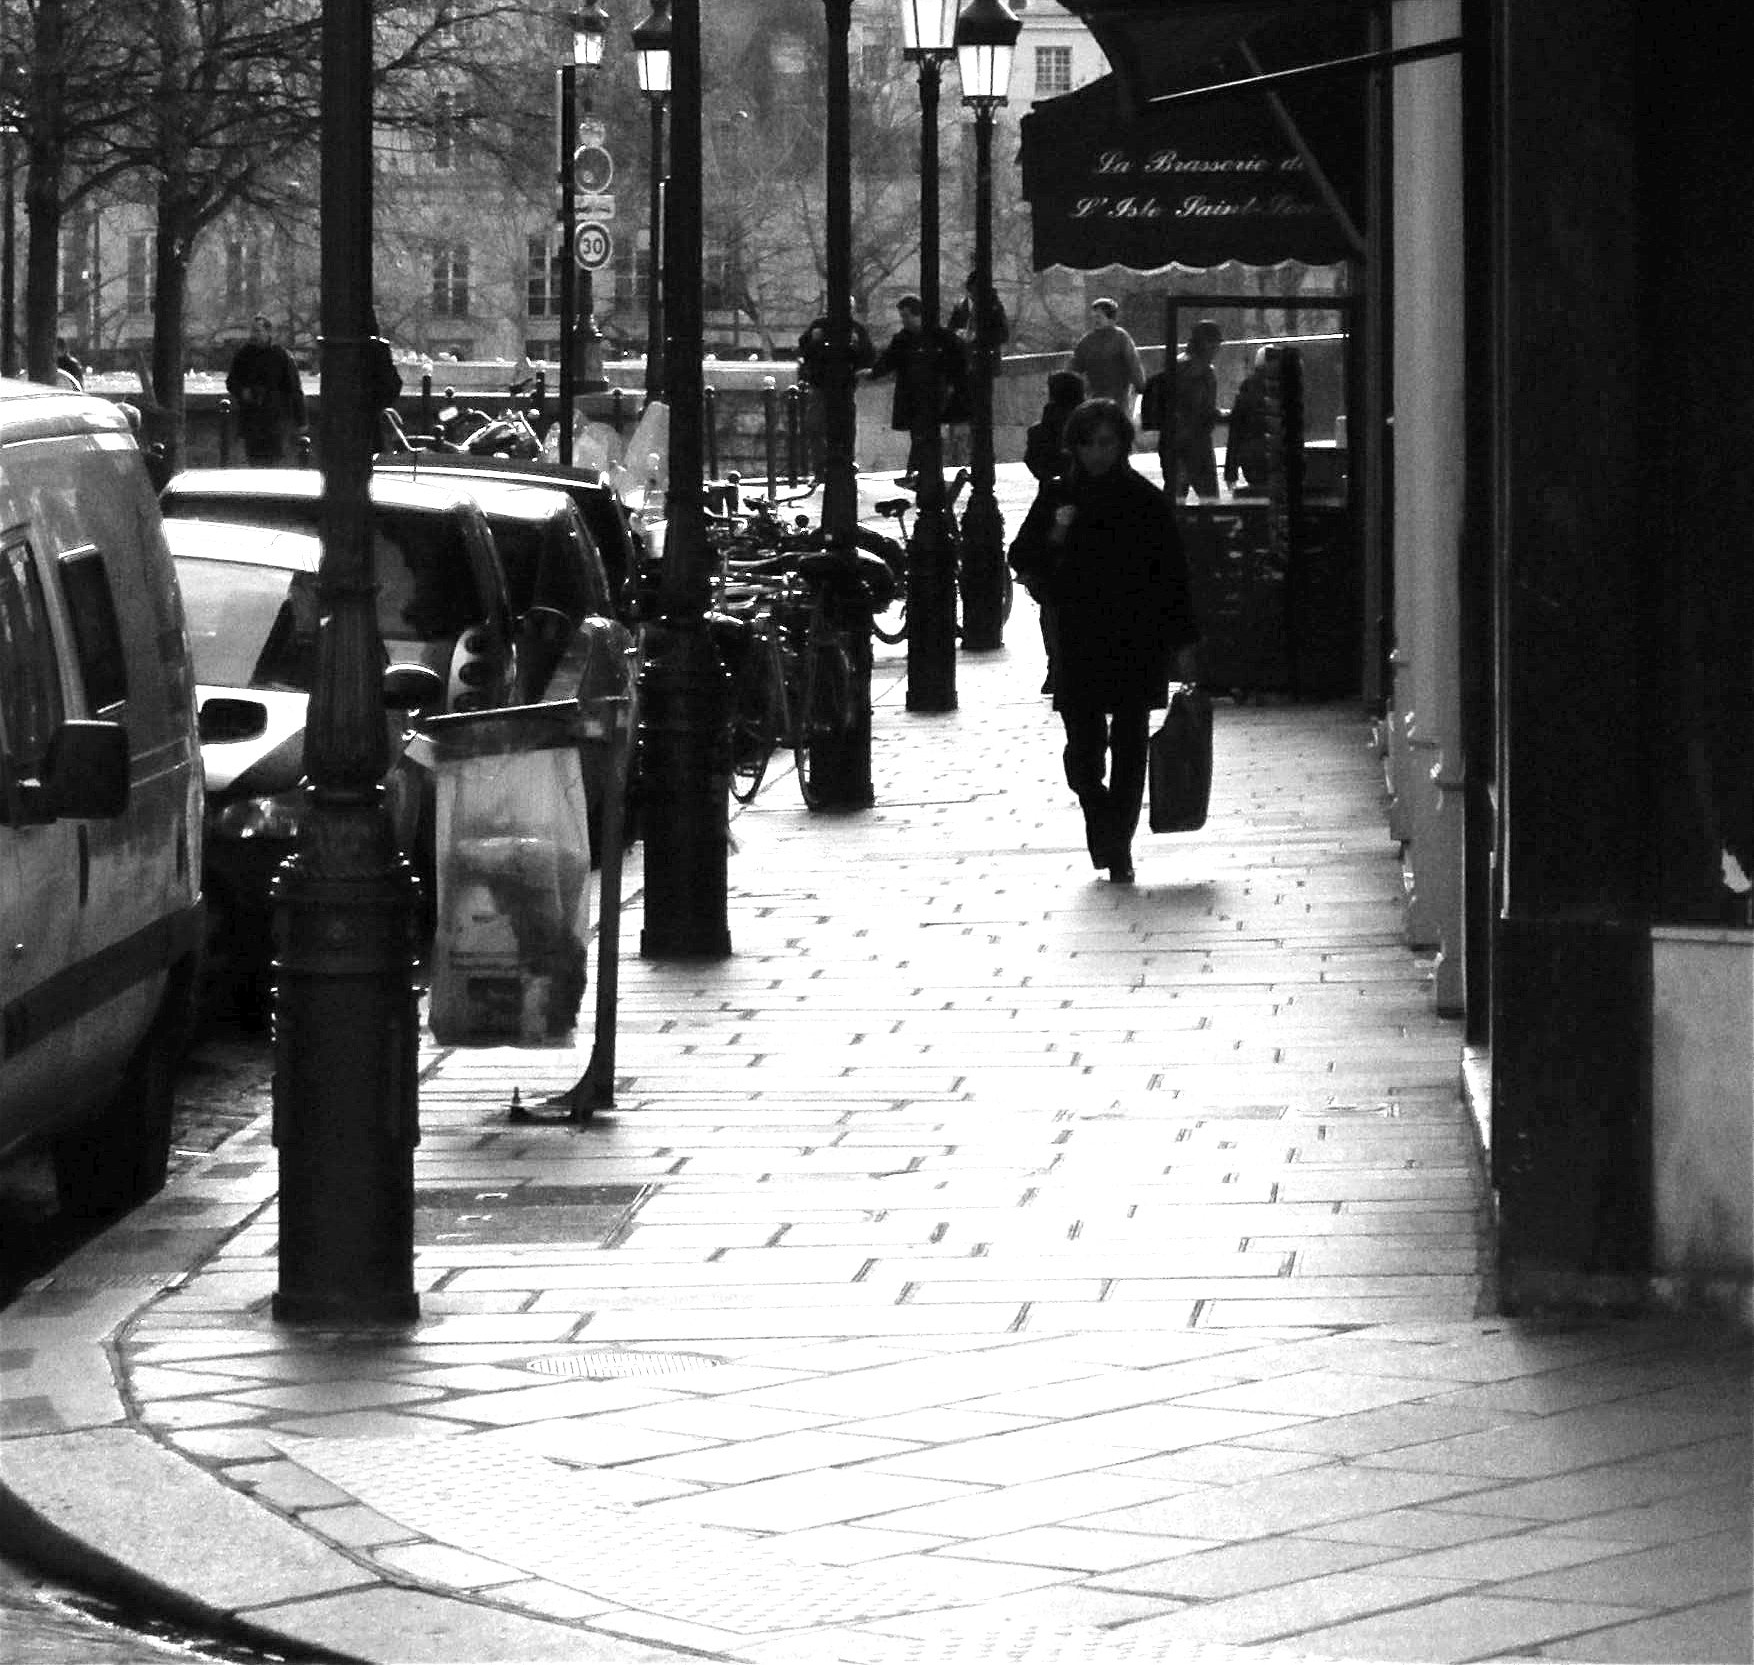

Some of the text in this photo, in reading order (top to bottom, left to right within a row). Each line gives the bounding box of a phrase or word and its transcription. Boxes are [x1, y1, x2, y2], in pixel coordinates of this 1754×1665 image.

[1095, 150, 1130, 174] La
[1143, 149, 1269, 174] Brasserie
[583, 238, 603, 254] 30
